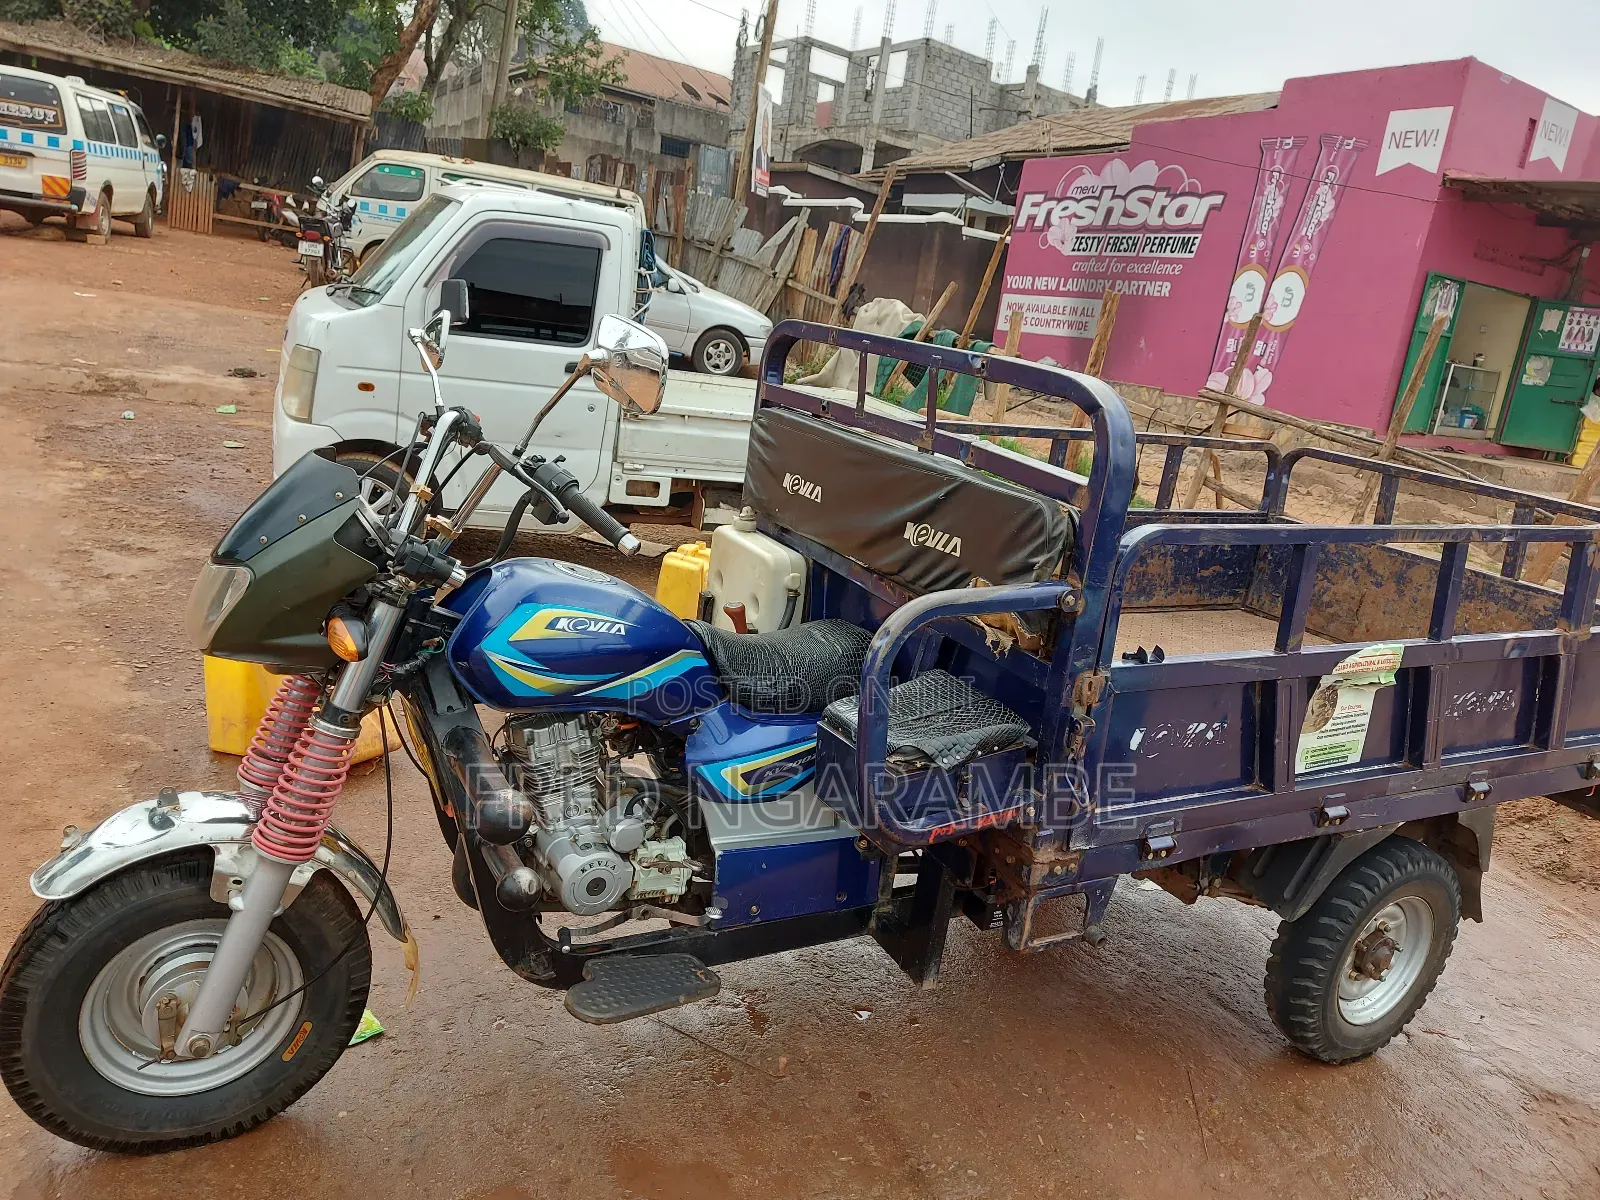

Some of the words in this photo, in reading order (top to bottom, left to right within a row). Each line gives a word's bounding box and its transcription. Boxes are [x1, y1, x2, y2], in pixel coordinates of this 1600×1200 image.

[1388, 128, 1440, 150] NEW!
[1539, 119, 1570, 148] NEW!
[1071, 184, 1099, 195] meru
[1014, 185, 1227, 231] FreshStar
[1071, 235, 1105, 254] ZESTY
[1104, 236, 1139, 254] FRESH
[1141, 235, 1199, 255] PERFUME
[1072, 258, 1109, 275] crafted
[1108, 258, 1125, 275] for
[1126, 259, 1184, 276] excellence
[1006, 275, 1034, 290] YOUR
[1034, 276, 1060, 292] NEW
[1059, 277, 1113, 293] LAUNDRY
[1114, 280, 1172, 298] PARTNER
[1006, 301, 1026, 312] NOW
[1025, 302, 1068, 317] AVAILABLE
[1068, 306, 1079, 317] IN
[1079, 307, 1097, 318] ALL
[1029, 316, 1089, 333] COUNTRYWIDE
[579, 860, 617, 876] KEVLA
